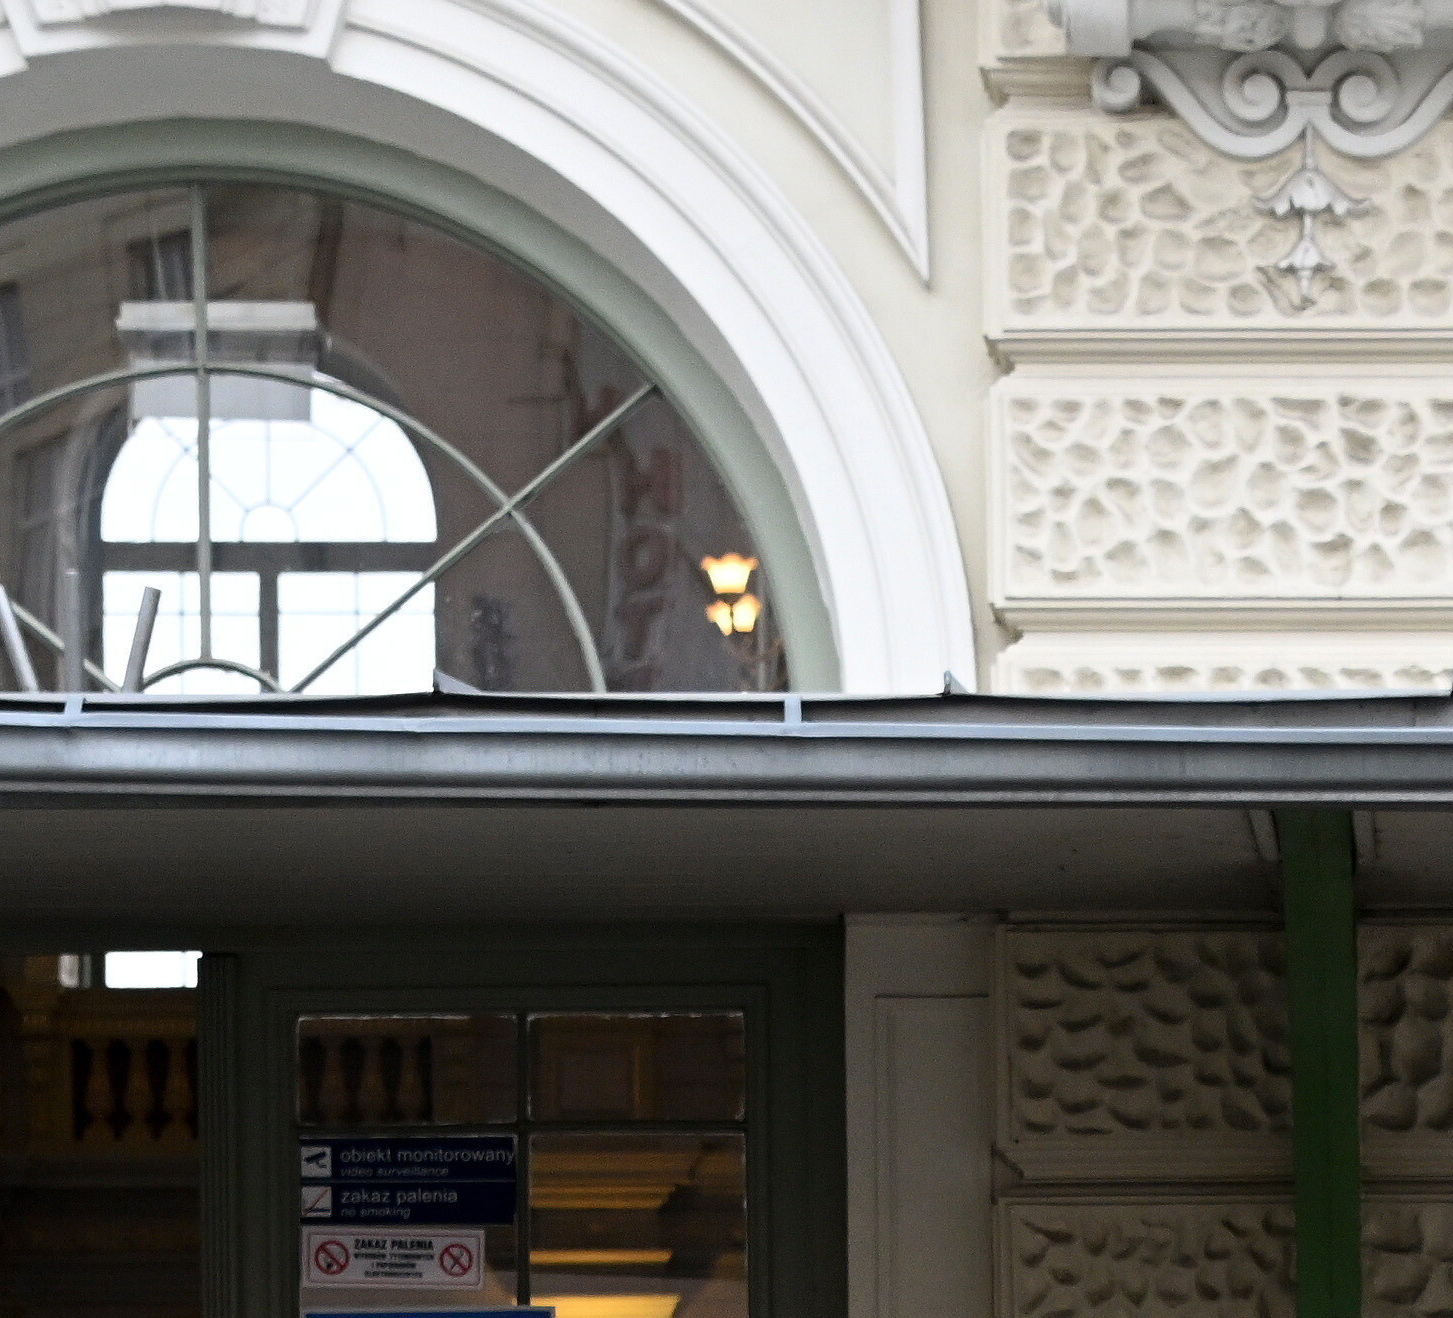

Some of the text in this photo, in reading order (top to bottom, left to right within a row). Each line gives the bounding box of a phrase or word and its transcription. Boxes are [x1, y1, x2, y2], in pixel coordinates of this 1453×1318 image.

[339, 1147, 515, 1166] obiekt monitorowany
[341, 1187, 458, 1205] zakaz palenia
